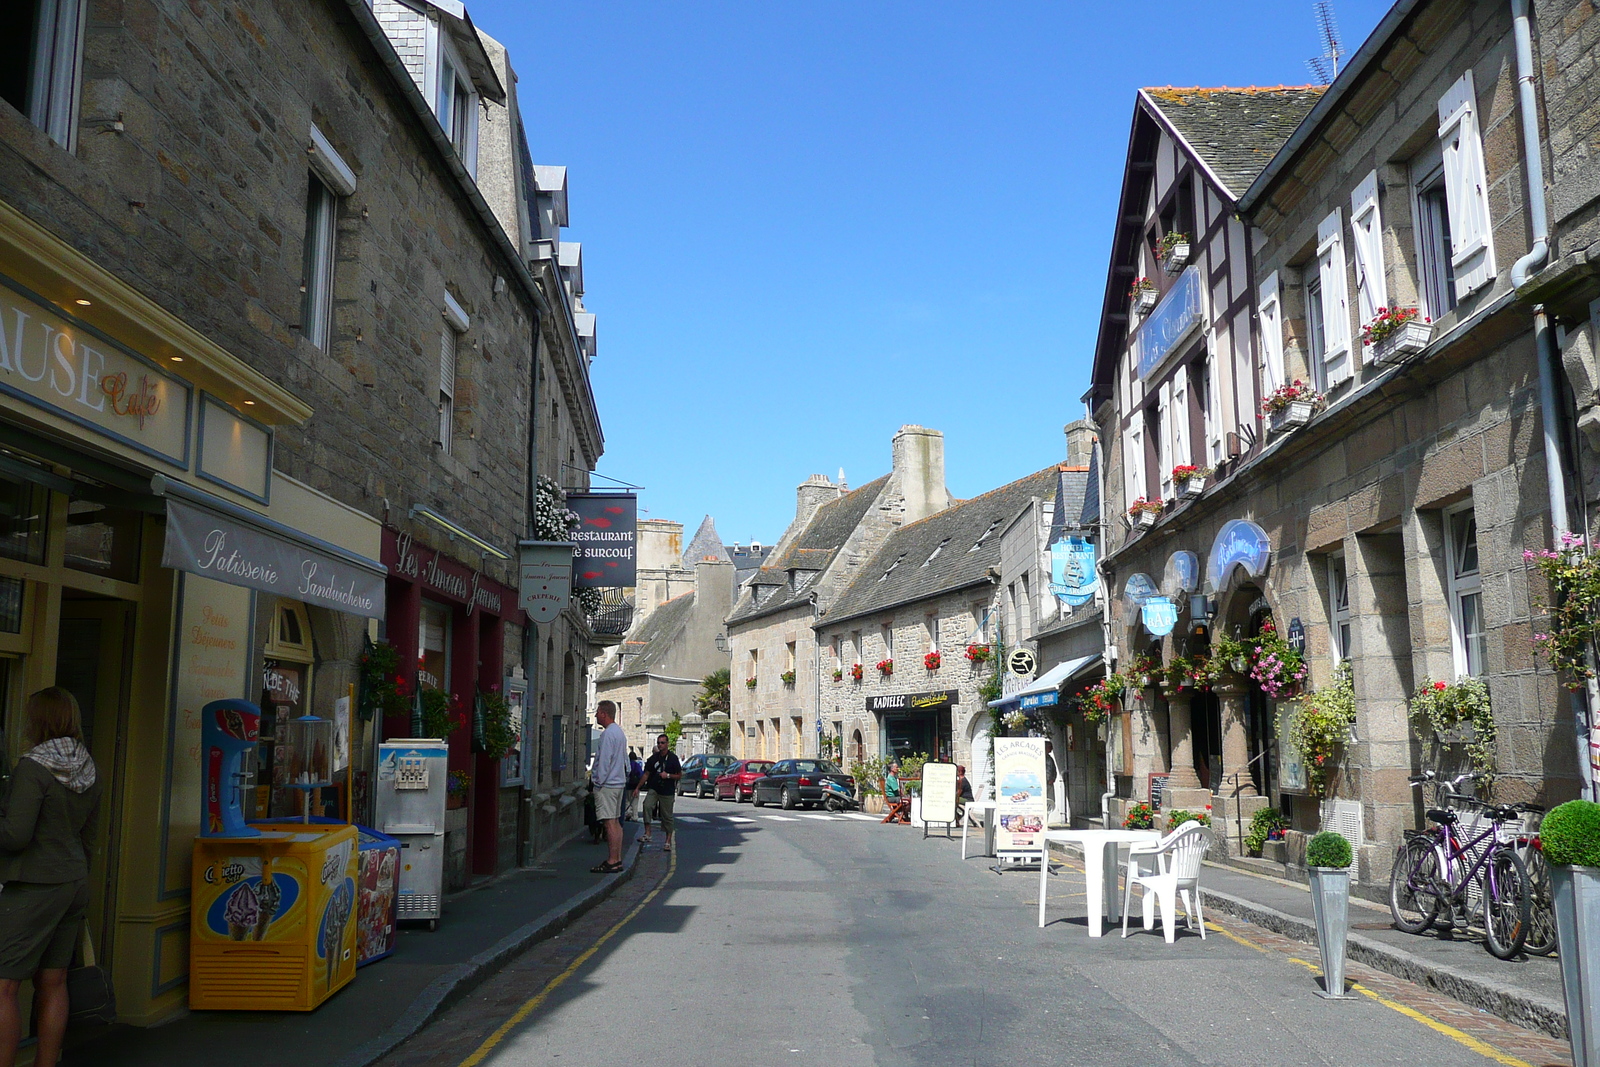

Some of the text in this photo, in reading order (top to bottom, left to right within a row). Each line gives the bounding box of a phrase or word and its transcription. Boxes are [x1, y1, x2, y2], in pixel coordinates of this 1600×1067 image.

[101, 372, 161, 431] Café
[198, 529, 373, 610] Patisserie Sandwicherie
[395, 529, 501, 617] Les Amours Jaunes
[1148, 612, 1173, 628] BAR
[873, 695, 905, 709] RADIELEC
[996, 740, 1044, 757] LES ARCADES
